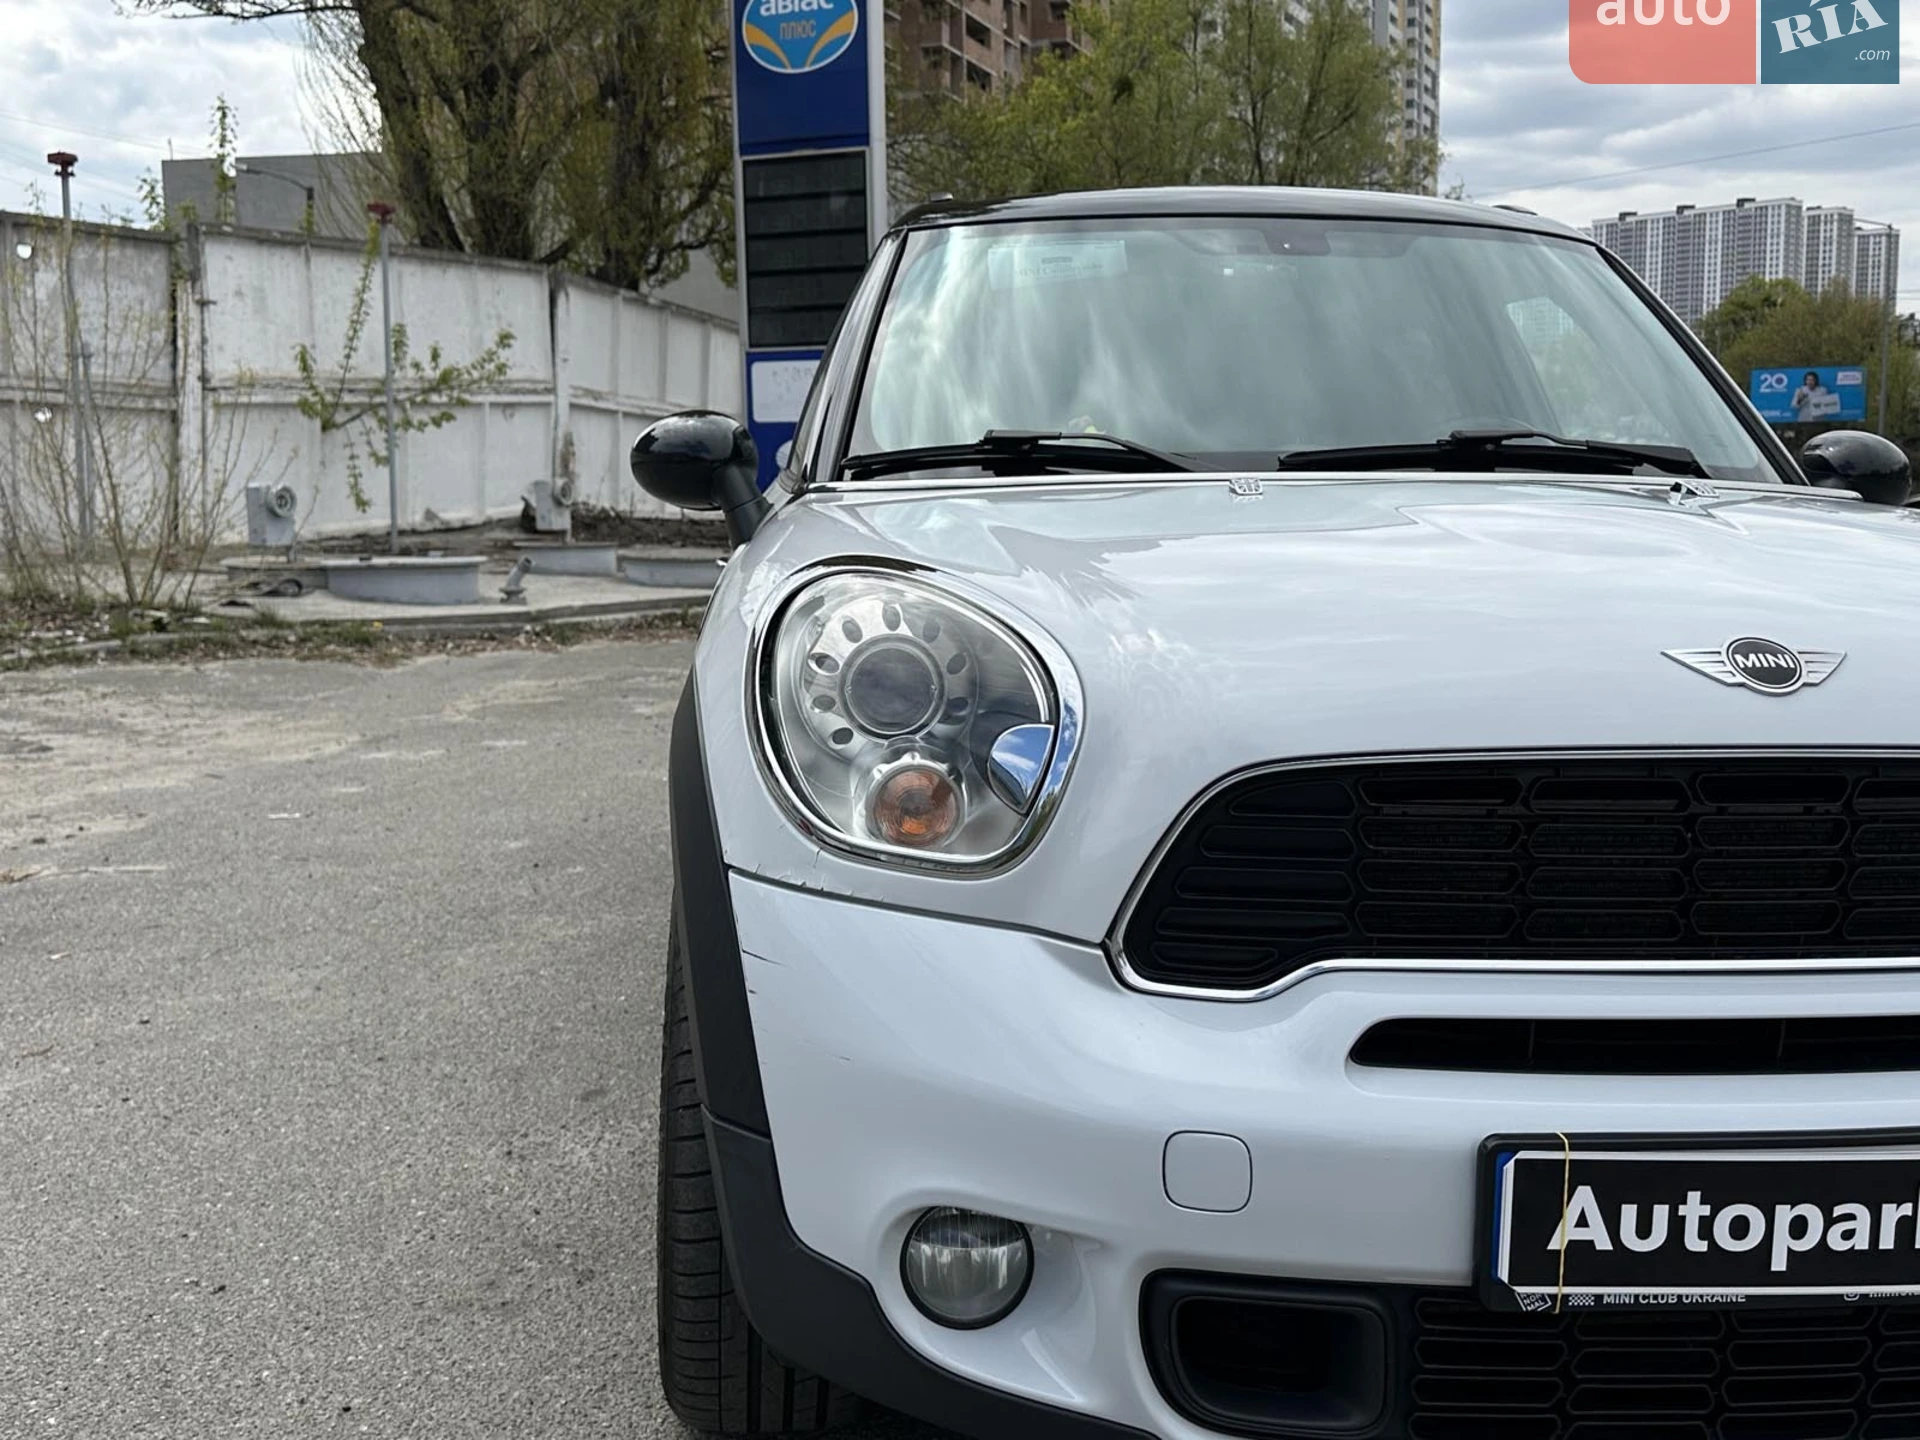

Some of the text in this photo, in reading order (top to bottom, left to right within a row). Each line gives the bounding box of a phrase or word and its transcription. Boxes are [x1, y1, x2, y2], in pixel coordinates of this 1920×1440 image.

[1760, 373, 1788, 389] 20
[1733, 653, 1796, 669] MINI
[1546, 1184, 1920, 1272] Autopar
[1602, 1293, 1634, 1304] MINI
[1639, 1293, 1678, 1304] CLUB
